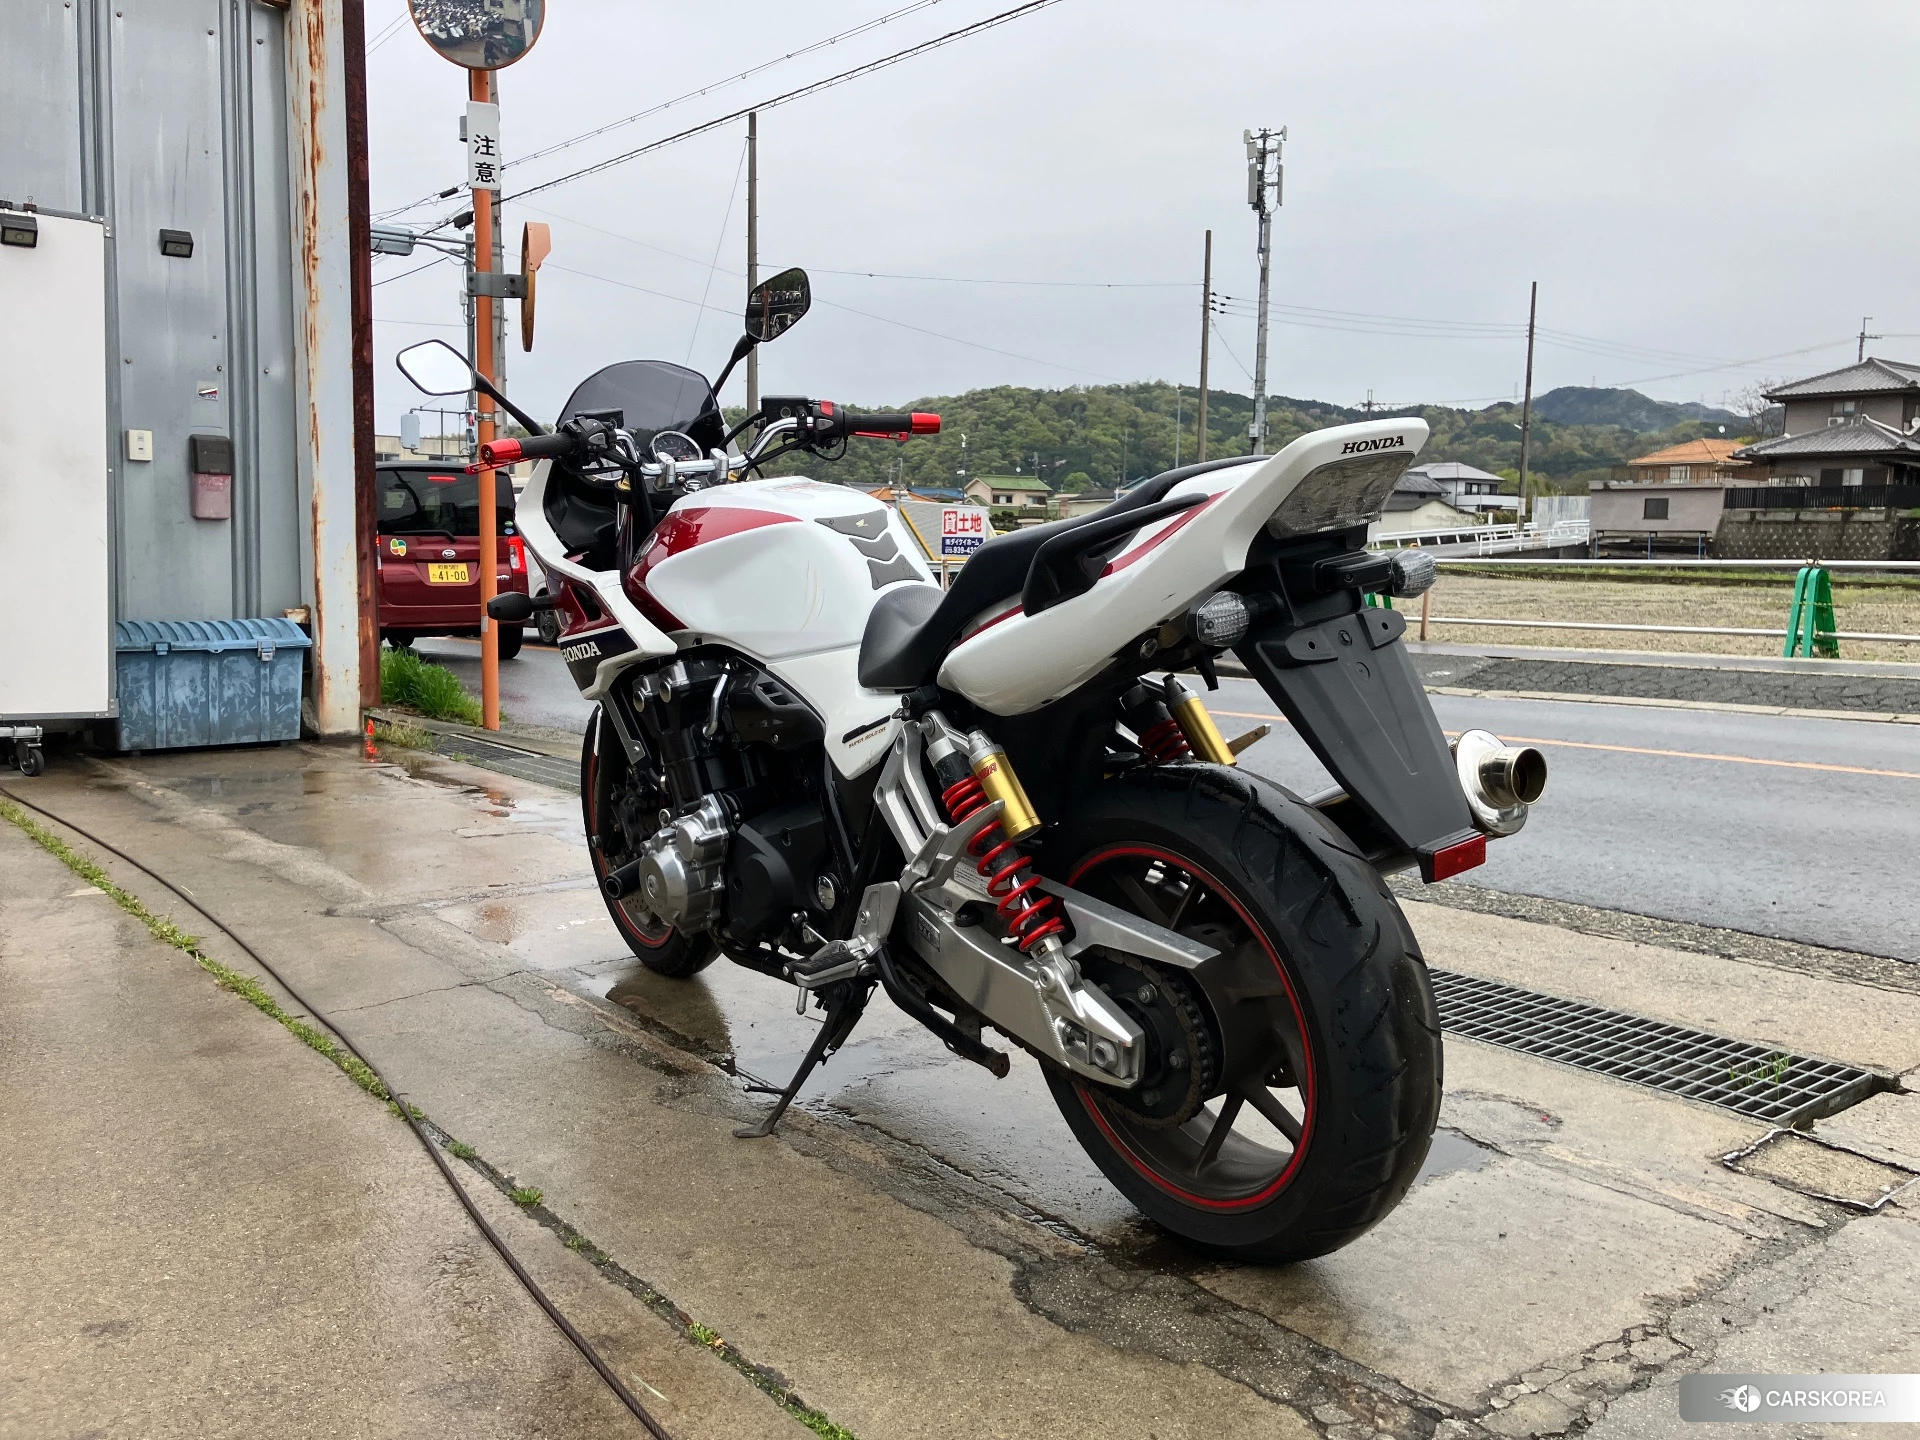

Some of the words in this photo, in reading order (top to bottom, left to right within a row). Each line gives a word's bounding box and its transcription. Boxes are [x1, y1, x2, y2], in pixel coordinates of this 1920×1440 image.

[473, 134, 496, 184] 注意
[1340, 436, 1404, 454] HONDA
[944, 511, 981, 534] 貸土地
